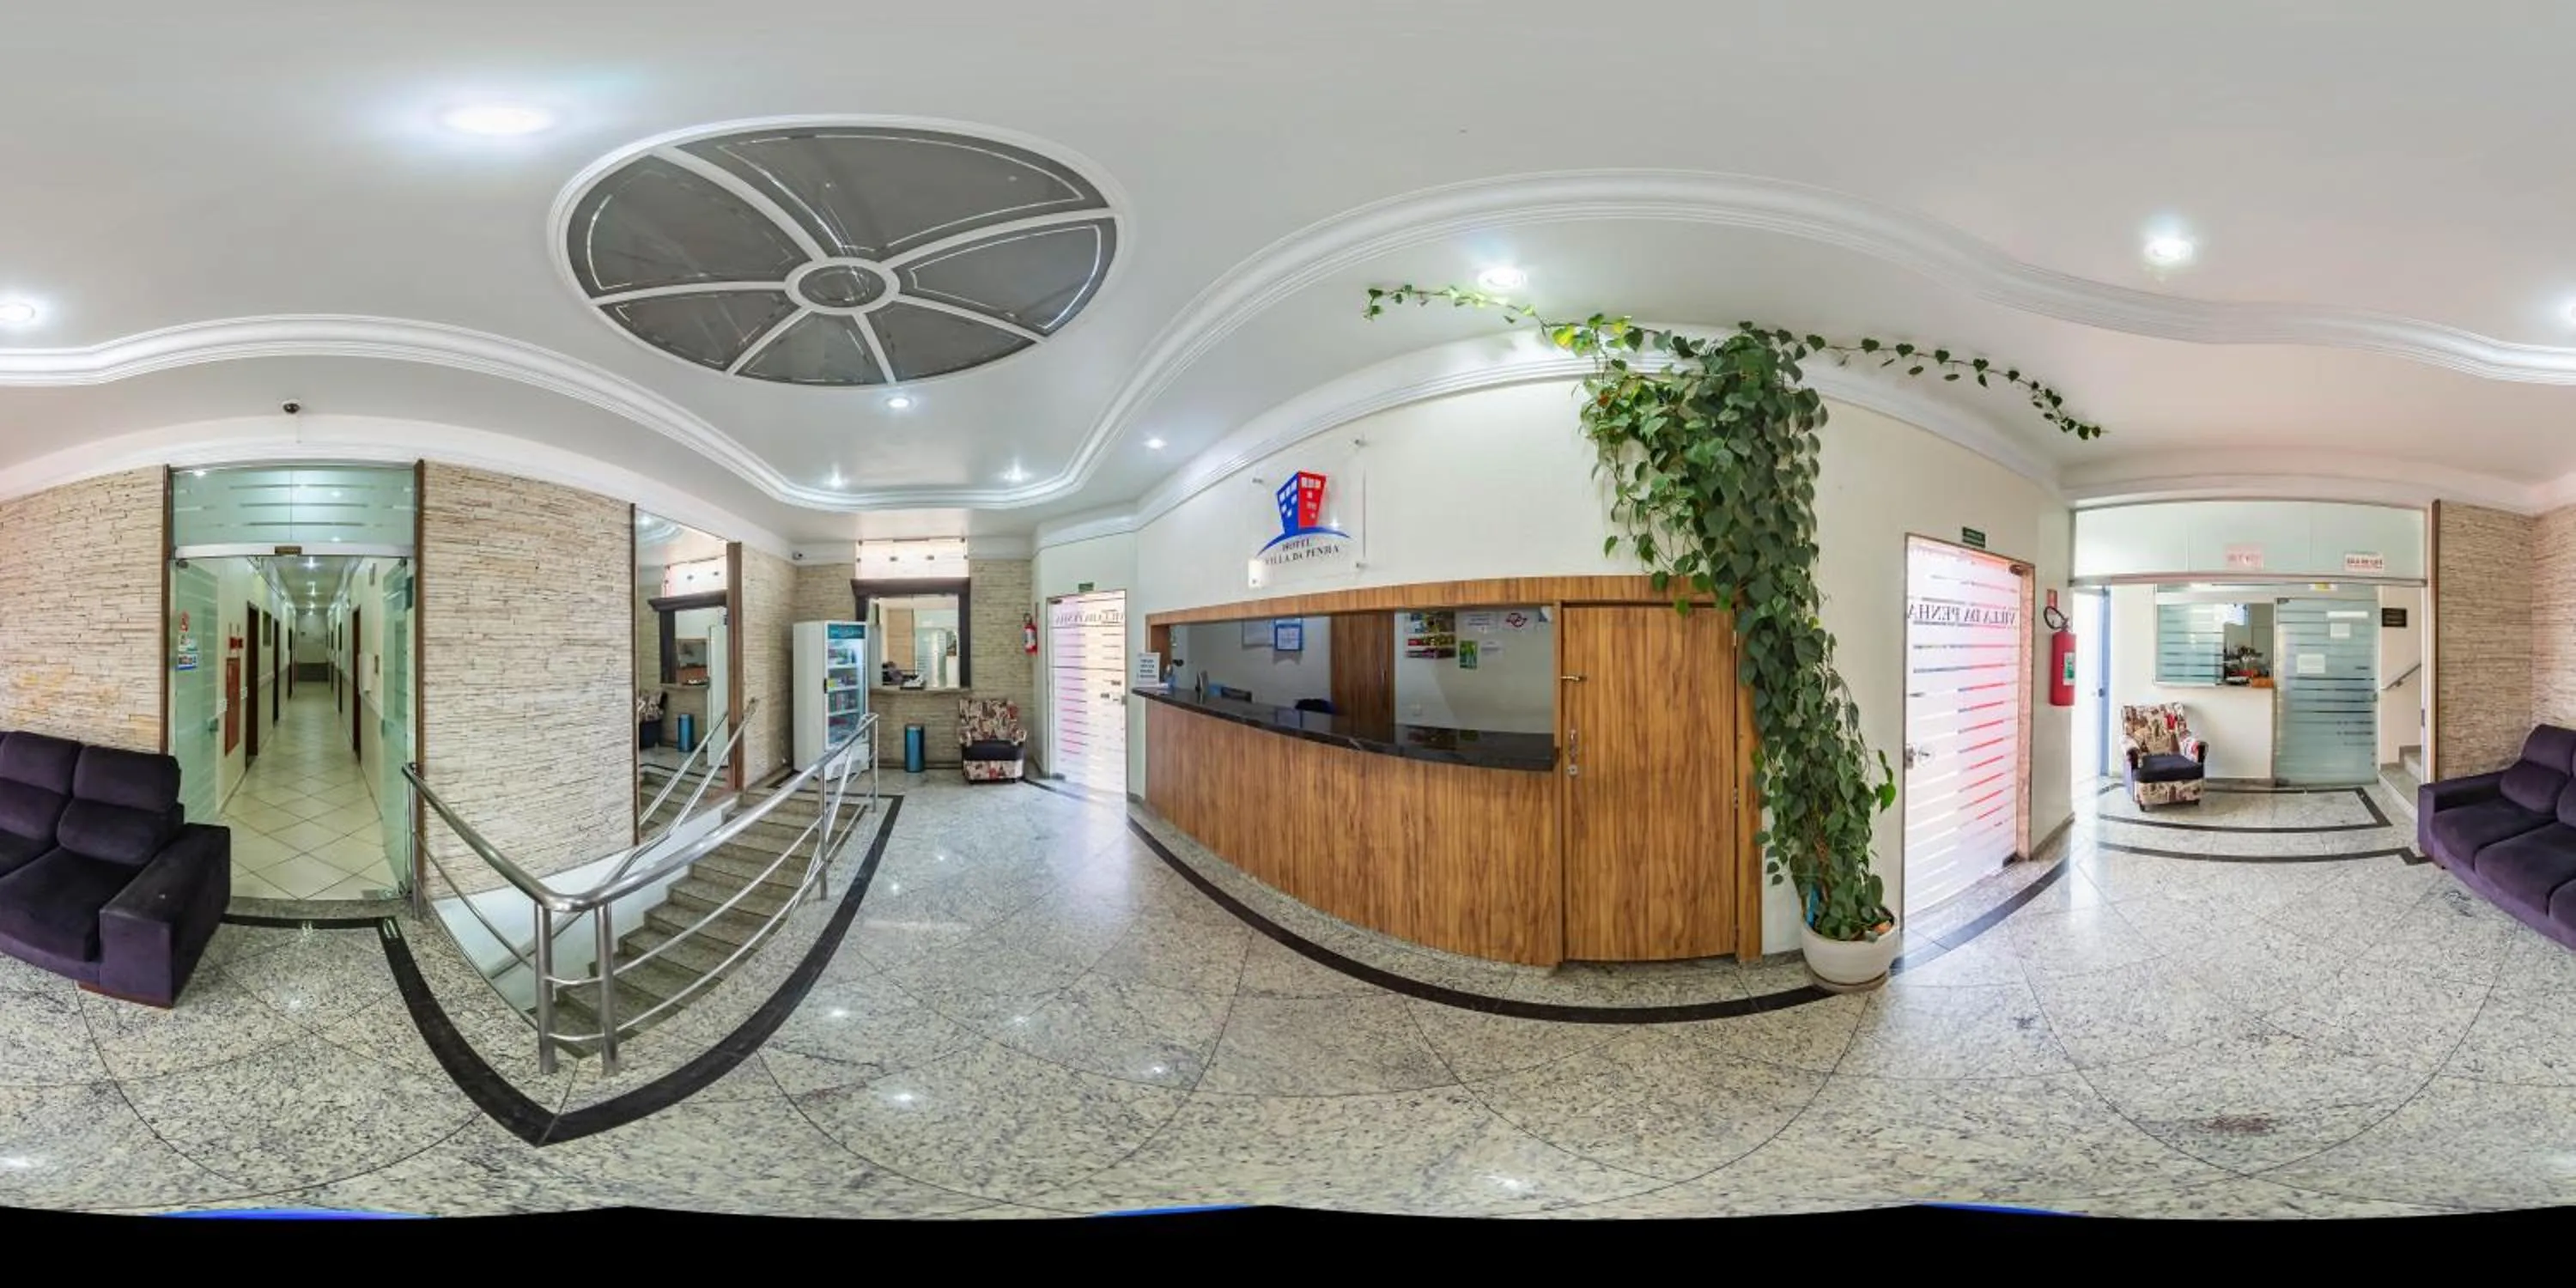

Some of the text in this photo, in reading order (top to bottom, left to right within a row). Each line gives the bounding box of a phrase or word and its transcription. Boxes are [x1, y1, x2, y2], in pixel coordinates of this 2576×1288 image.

[1281, 538, 1311, 551] HOTEL
[1265, 544, 1340, 564] VILLA DA PENHA
